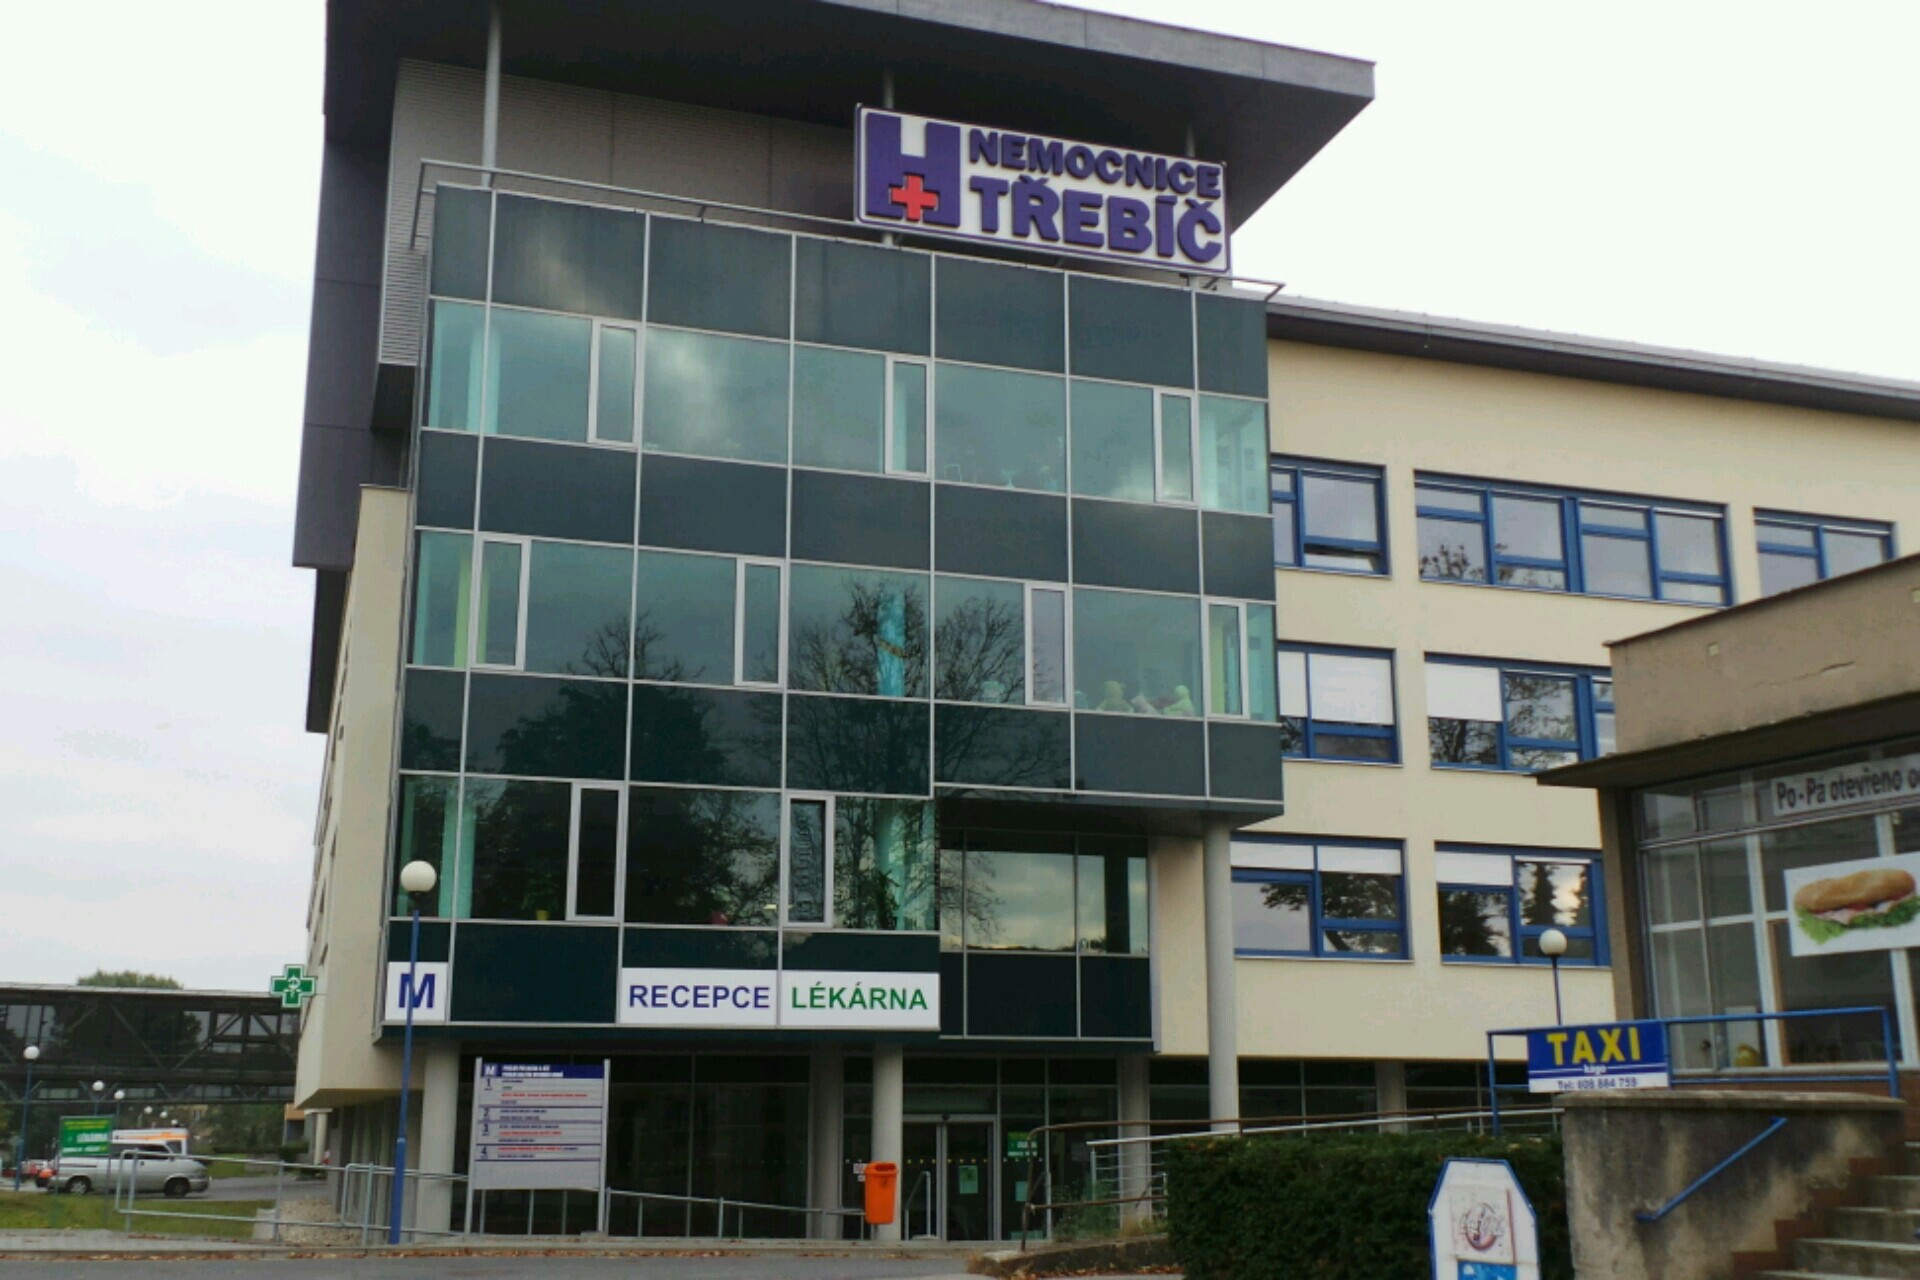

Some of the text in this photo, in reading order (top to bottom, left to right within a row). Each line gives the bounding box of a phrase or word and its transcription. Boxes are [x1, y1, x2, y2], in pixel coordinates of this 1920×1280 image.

[969, 128, 1222, 199] NEMOCNICE
[969, 174, 1223, 263] TŘEBÍČ
[399, 973, 436, 1009] M
[628, 984, 771, 1009] RECEPCE
[791, 981, 928, 1010] LÉKÁRNA
[1546, 1027, 1642, 1066] TAXI
